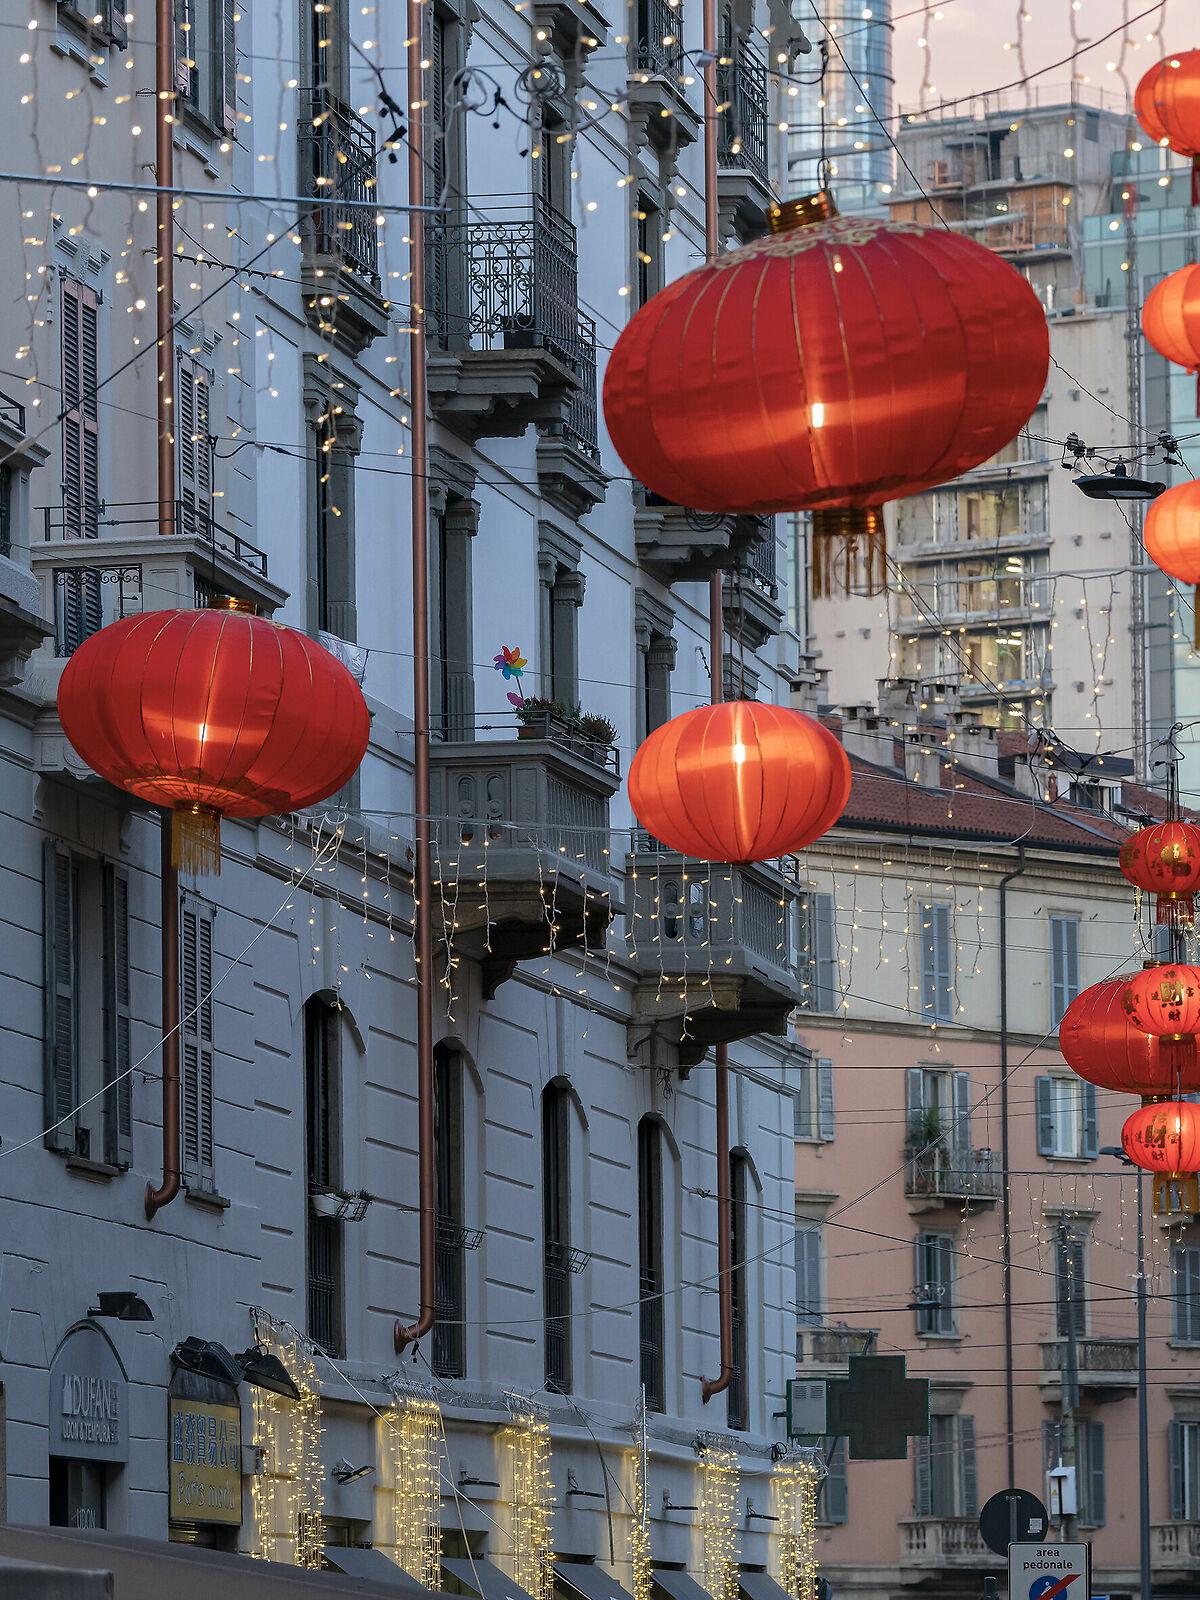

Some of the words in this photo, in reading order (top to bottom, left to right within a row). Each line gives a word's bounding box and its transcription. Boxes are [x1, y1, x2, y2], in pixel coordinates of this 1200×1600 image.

[63, 1420, 79, 1440] UDON
[85, 1423, 111, 1442] TEMPURA
[1036, 1549, 1060, 1557] area
[1023, 1560, 1073, 1571] pedonale
